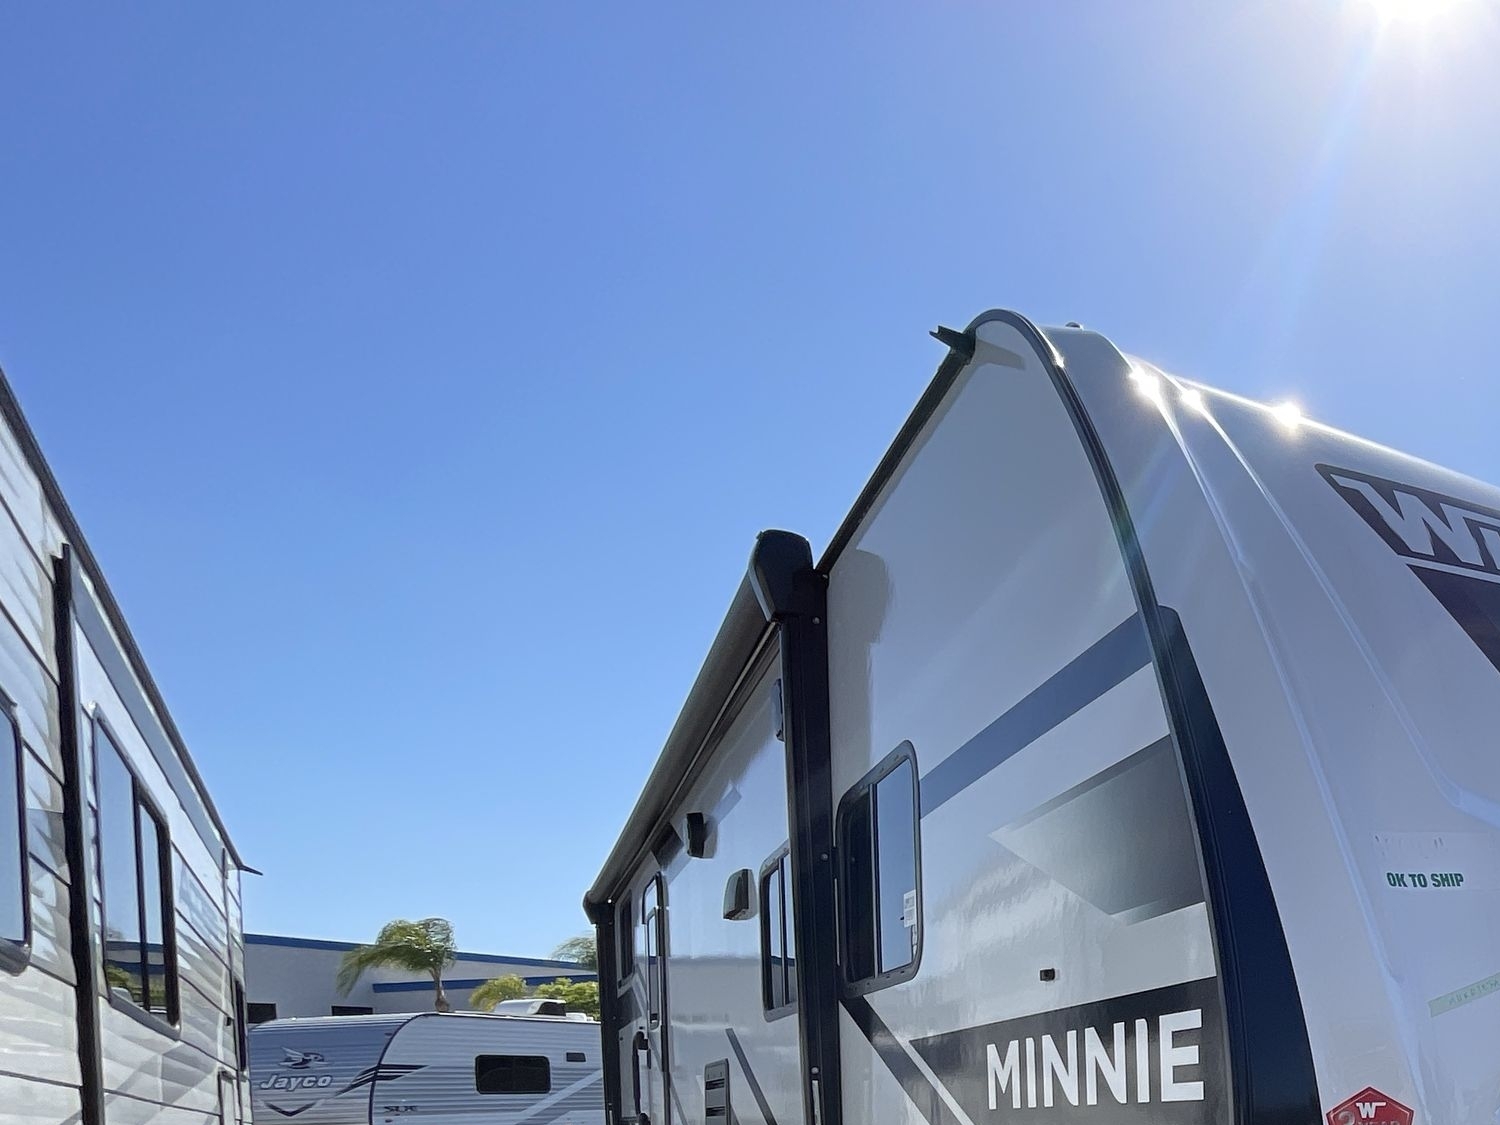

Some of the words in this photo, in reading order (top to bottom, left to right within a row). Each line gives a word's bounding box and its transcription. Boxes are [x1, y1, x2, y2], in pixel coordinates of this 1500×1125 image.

[1386, 872, 1408, 888] OK
[1408, 873, 1428, 888] TO
[1430, 873, 1464, 888] SHIP
[986, 1008, 1205, 1110] MINNIE
[260, 1074, 333, 1092] Jayco
